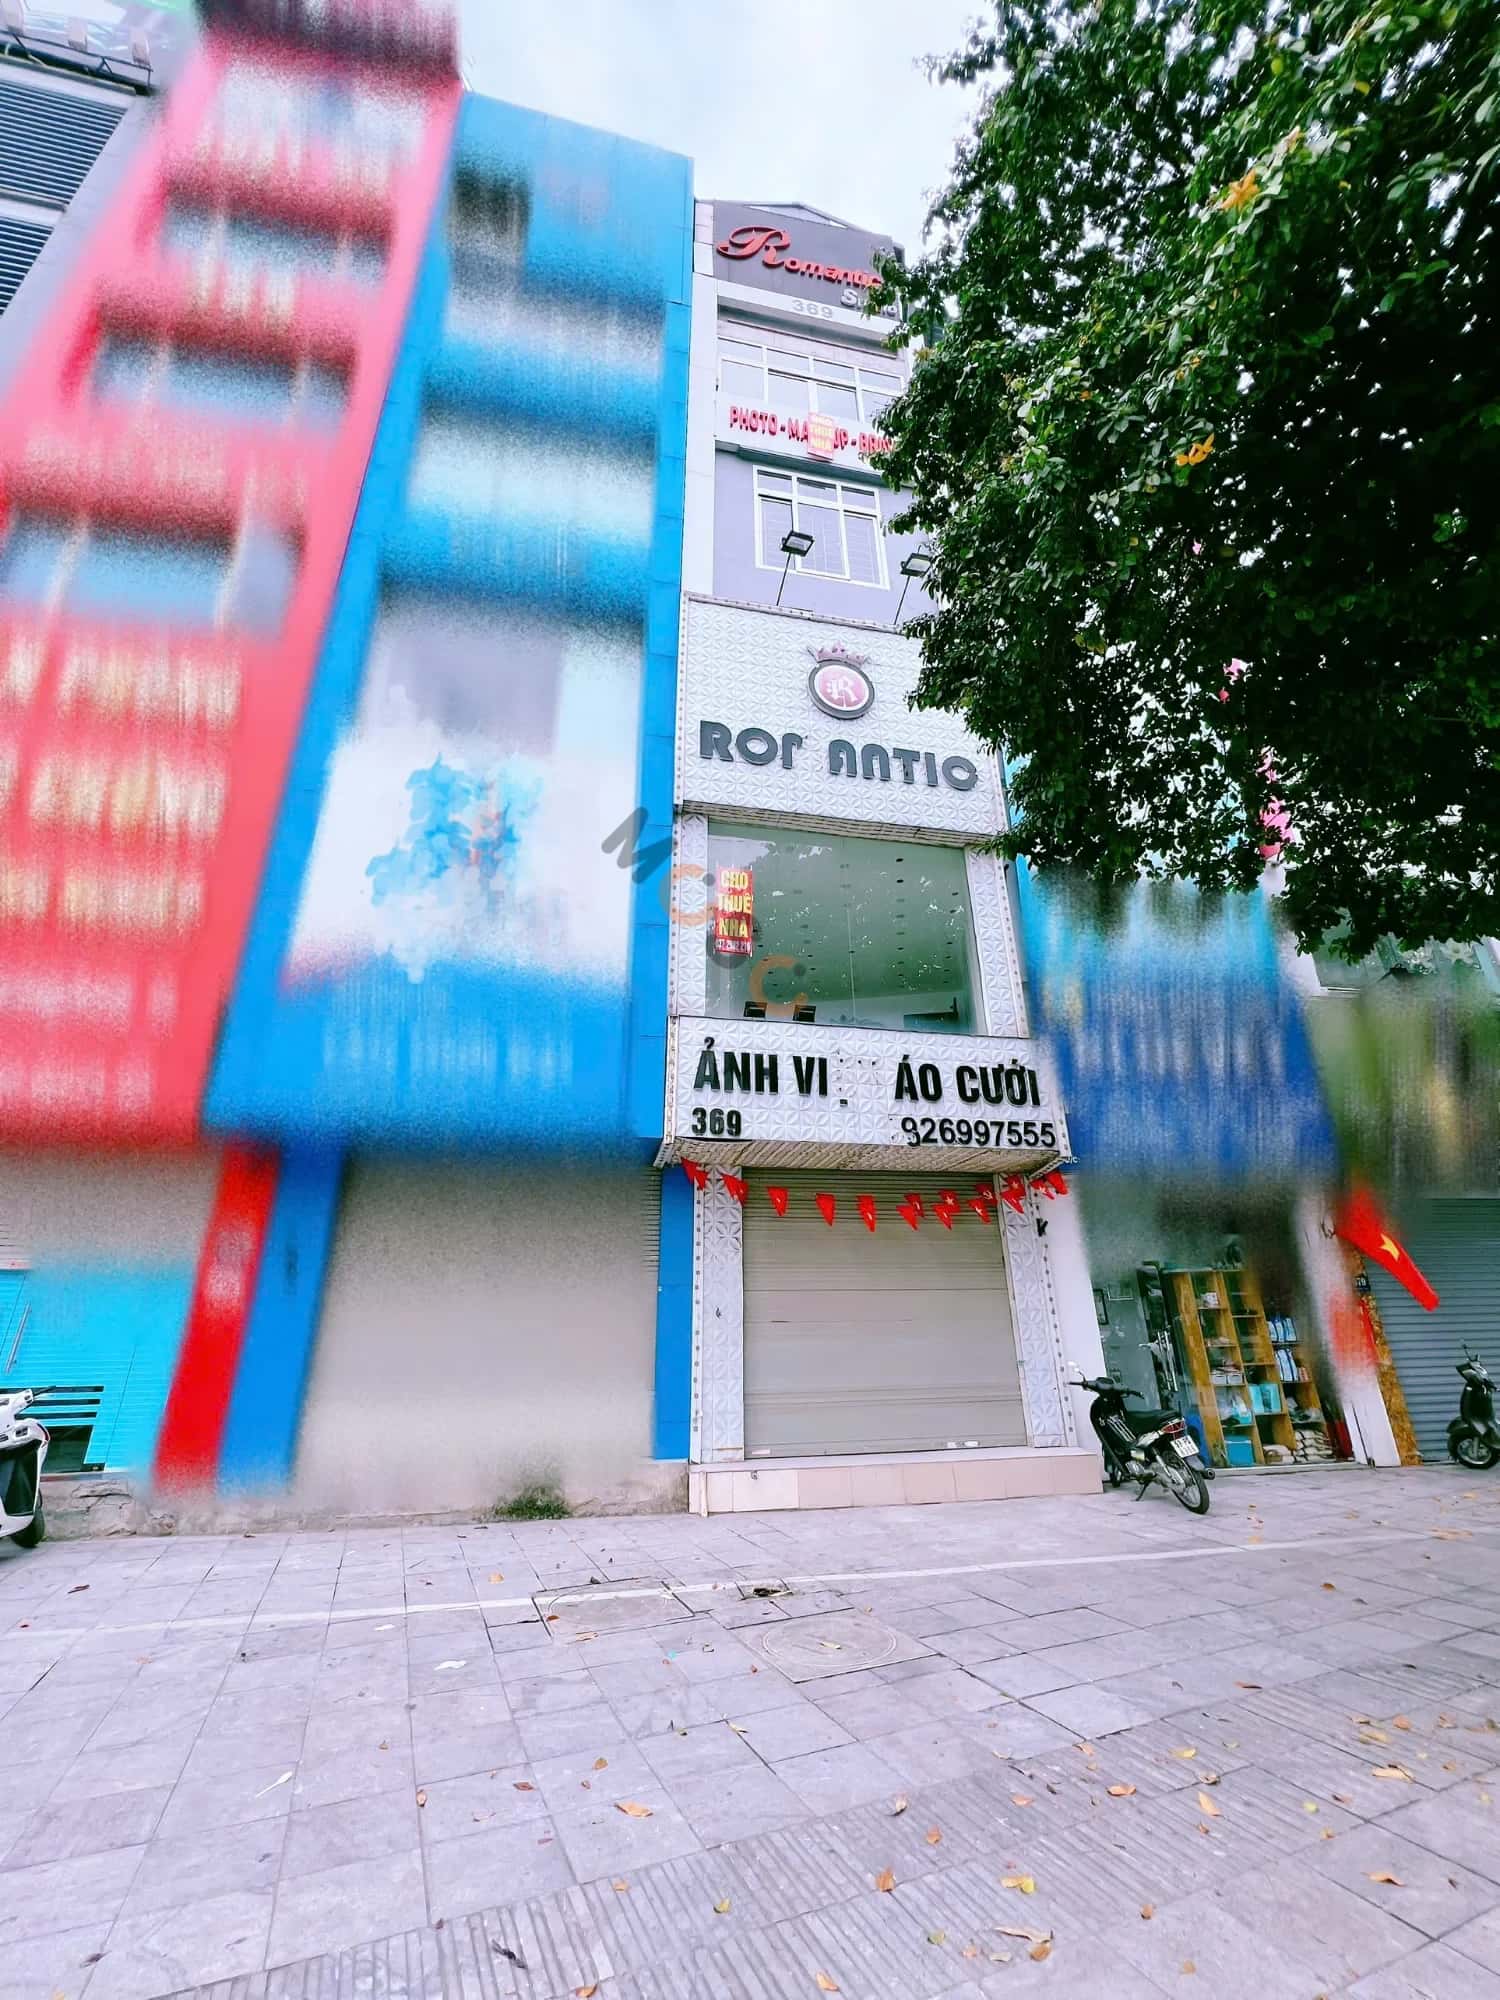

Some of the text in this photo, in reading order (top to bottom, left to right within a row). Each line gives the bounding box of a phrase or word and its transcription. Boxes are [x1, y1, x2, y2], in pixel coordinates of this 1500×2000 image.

[791, 299, 833, 318] 369
[729, 406, 778, 436] PHOTO
[721, 870, 749, 889] CHO
[718, 892, 752, 914] THUÊ
[693, 1036, 779, 1095] ẢNH
[894, 1054, 943, 1102] ÁO
[956, 1058, 1041, 1107] CƯỚI
[691, 1107, 742, 1137] 369
[900, 1116, 1057, 1148] 926997555
